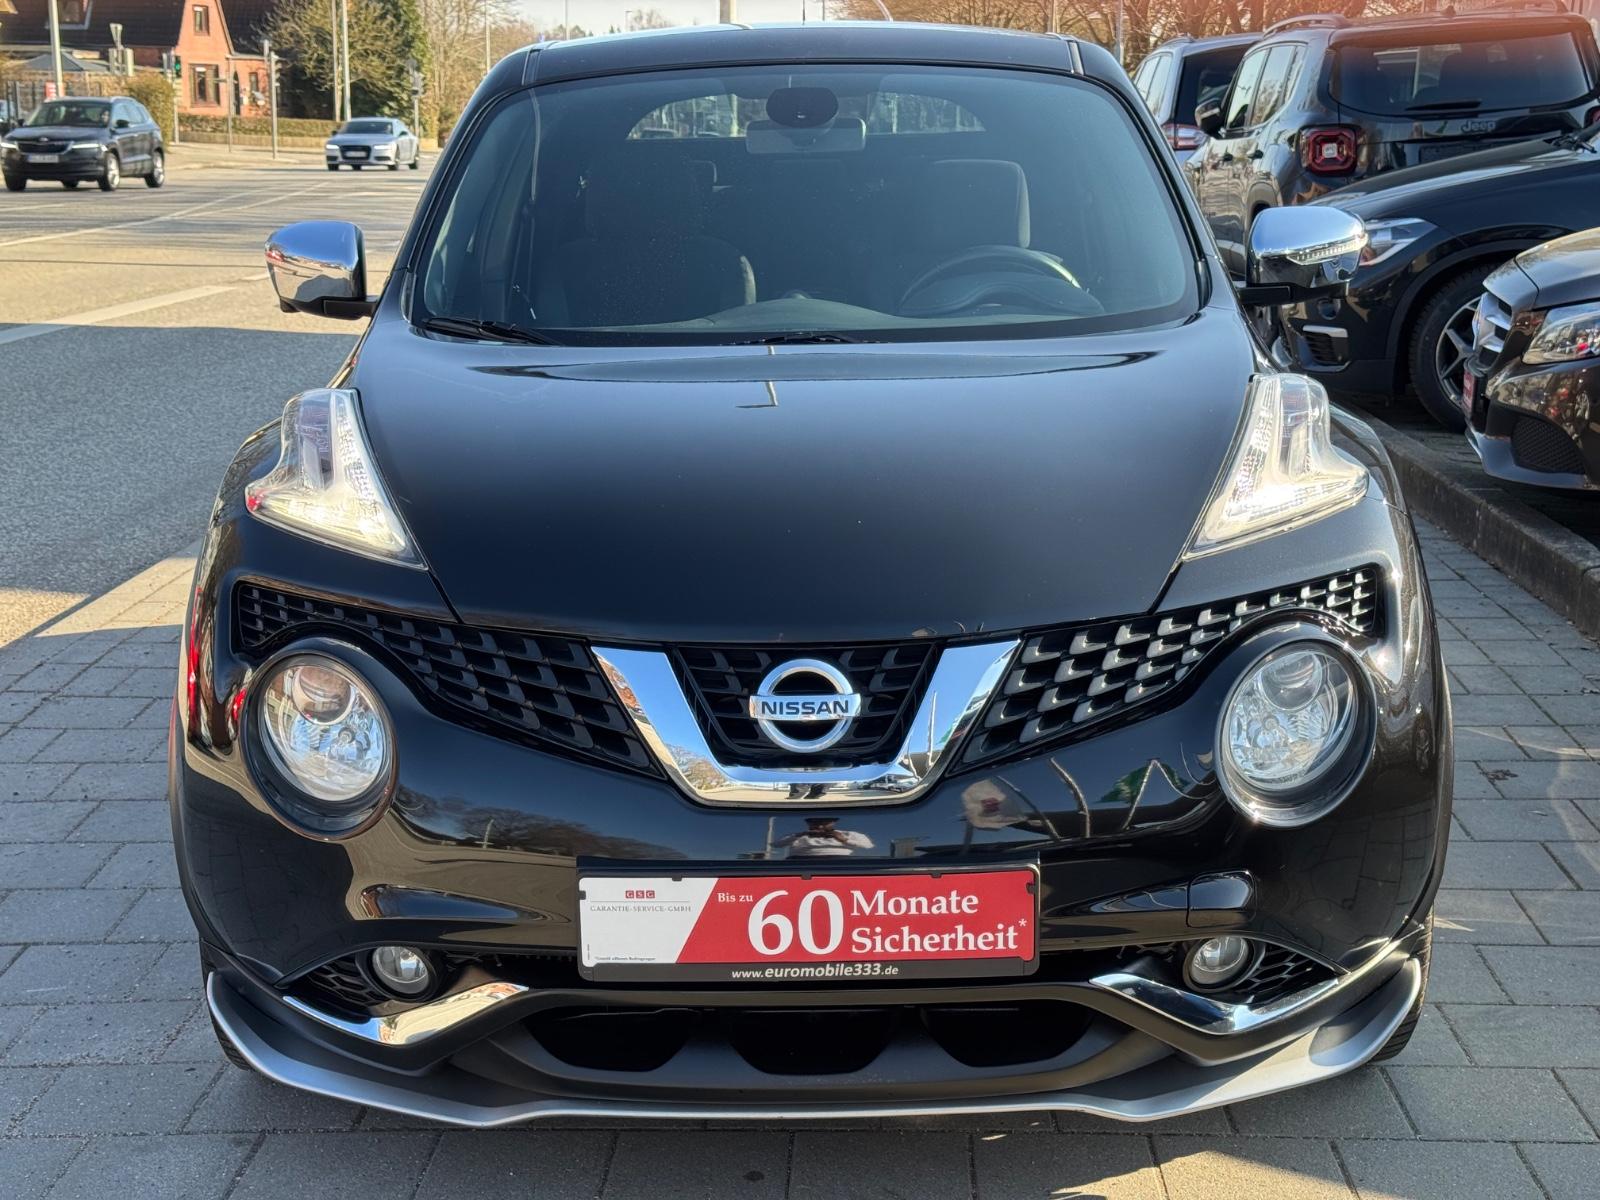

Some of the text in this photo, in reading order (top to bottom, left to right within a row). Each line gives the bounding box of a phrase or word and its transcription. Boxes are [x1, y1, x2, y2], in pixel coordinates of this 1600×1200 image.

[1461, 120, 1496, 133] Jeep
[761, 699, 849, 716] NISSAN
[717, 892, 754, 903] Bis zu
[850, 889, 979, 916] Monate
[748, 889, 845, 956] 60
[731, 962, 899, 979] www.euromobile333.de
